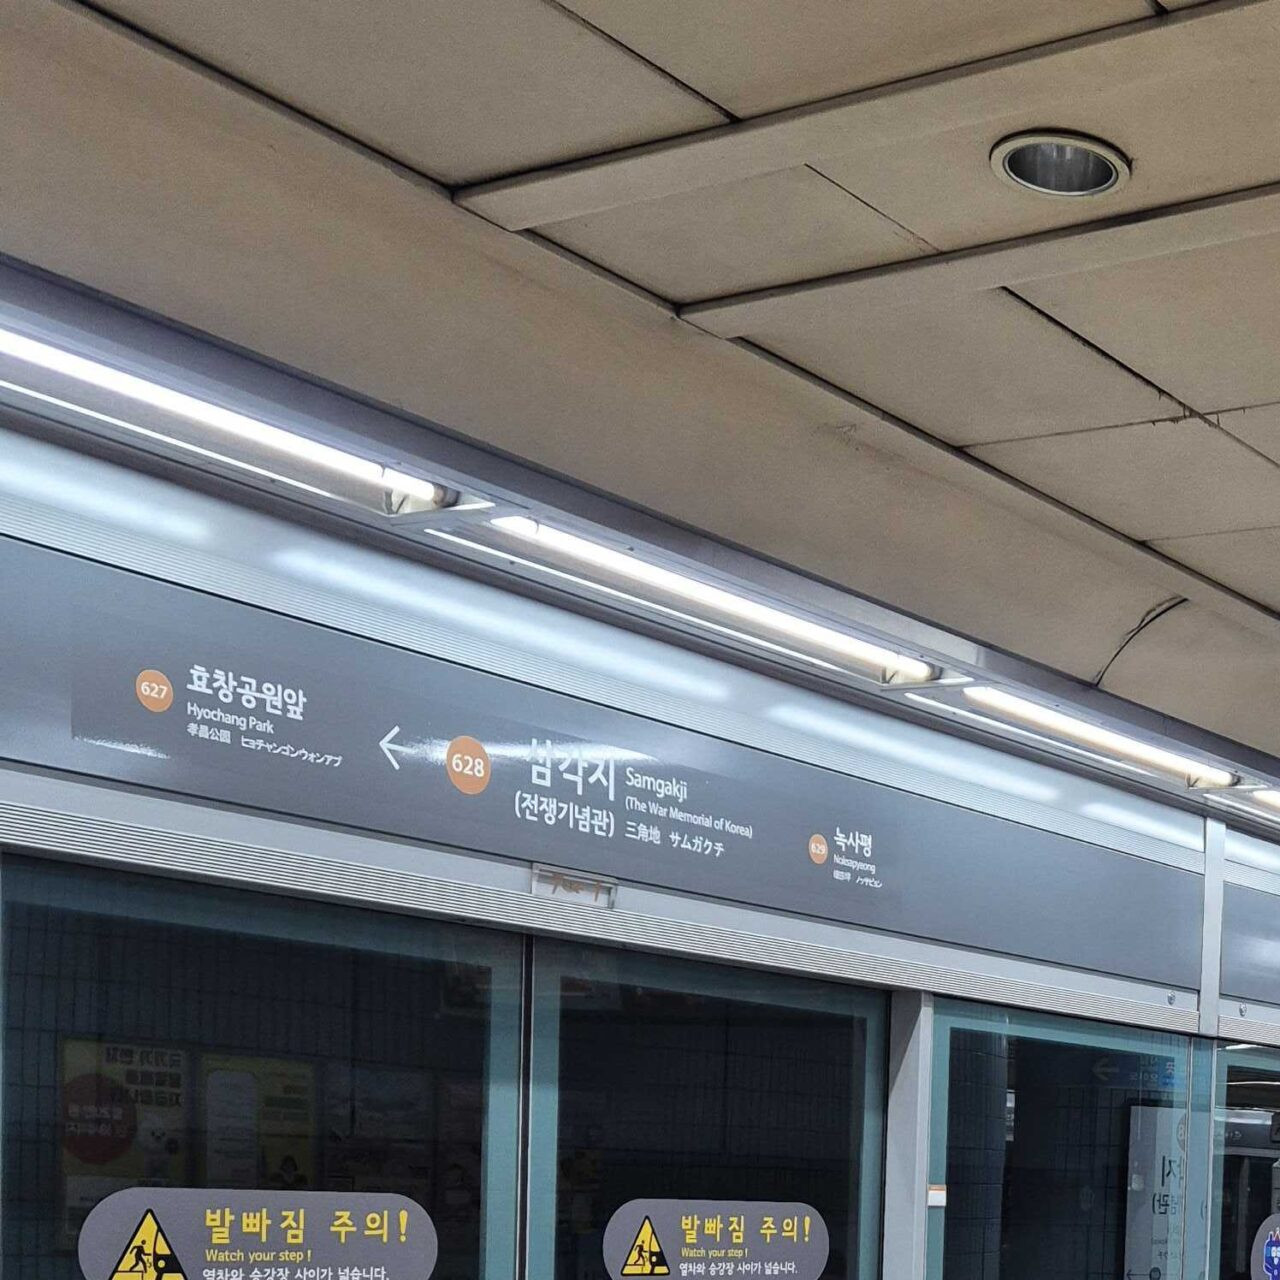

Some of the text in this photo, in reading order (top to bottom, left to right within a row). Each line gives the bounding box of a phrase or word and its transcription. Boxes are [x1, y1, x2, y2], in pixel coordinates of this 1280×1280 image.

[141, 681, 167, 699] 627
[187, 664, 307, 720] 효창공원앞
[187, 702, 275, 734] Hyochang Park
[451, 752, 486, 778] 628
[625, 767, 688, 803] Samgakji
[514, 790, 615, 838] (전쟁기념관)
[625, 796, 753, 839] (The War Memorial of Korea)
[625, 821, 725, 857] 三角地 サムガクチ
[833, 826, 872, 857] 녹사평
[205, 1249, 244, 1262] Watch
[248, 1250, 277, 1264] your
[679, 1261, 798, 1276] 열차와 승강장 사이가 넓습니다.
[681, 1247, 706, 1258] Watch
[708, 1248, 725, 1259] your
